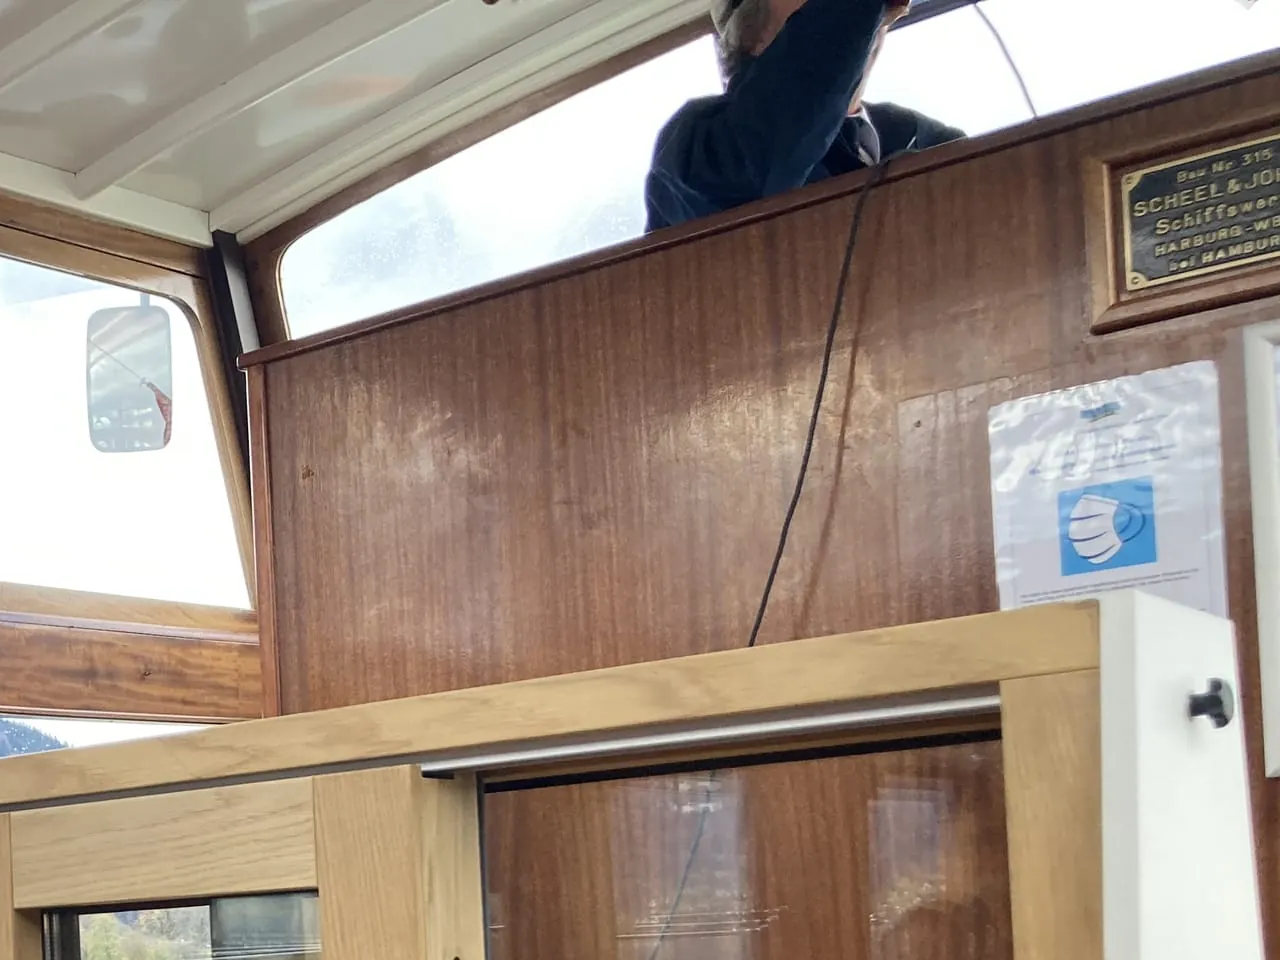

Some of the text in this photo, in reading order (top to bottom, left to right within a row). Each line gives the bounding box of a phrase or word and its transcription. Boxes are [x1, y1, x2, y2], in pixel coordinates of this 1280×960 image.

[1241, 148, 1273, 166] 315
[1133, 183, 1225, 217] SCHEEL
[1154, 194, 1280, 235] Schiffswer
